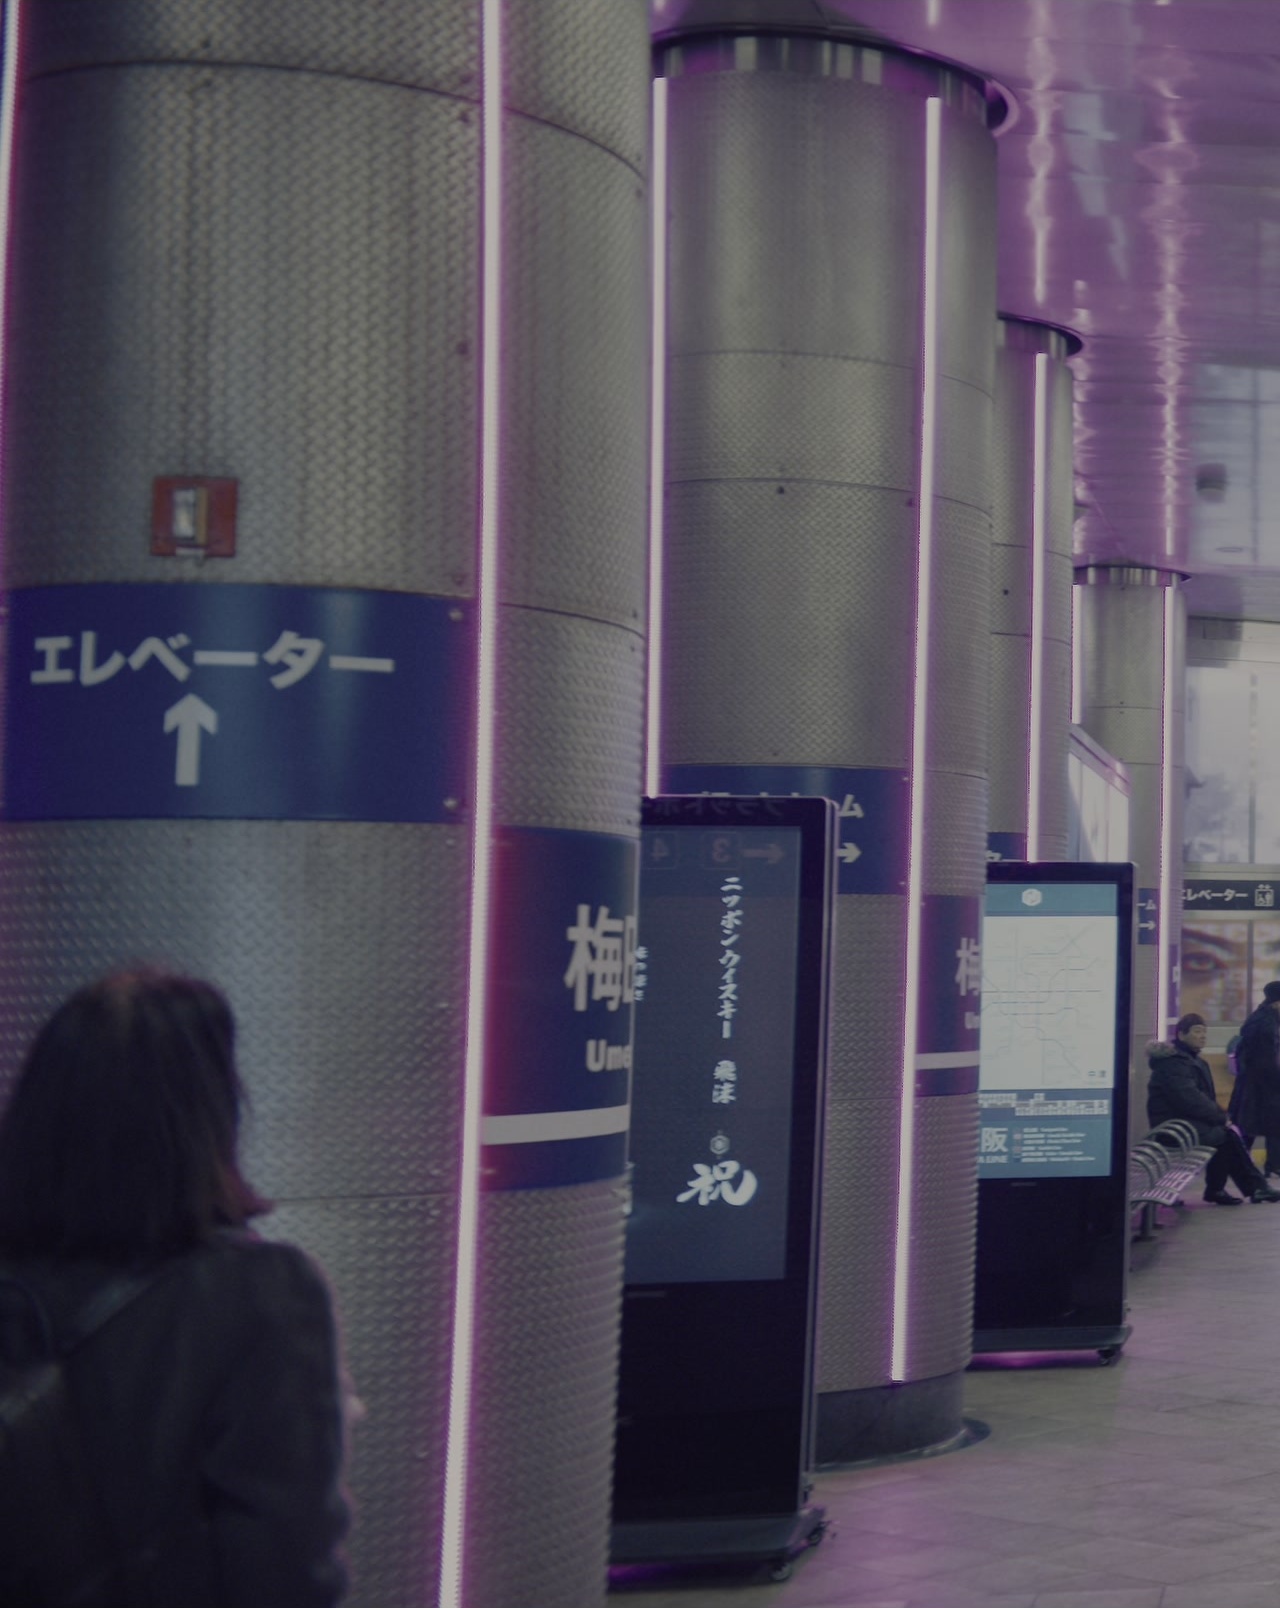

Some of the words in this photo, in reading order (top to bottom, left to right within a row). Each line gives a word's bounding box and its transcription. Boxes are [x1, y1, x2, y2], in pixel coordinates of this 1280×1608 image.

[30, 630, 395, 690] エレベーター
[676, 1160, 758, 1206] 祝
